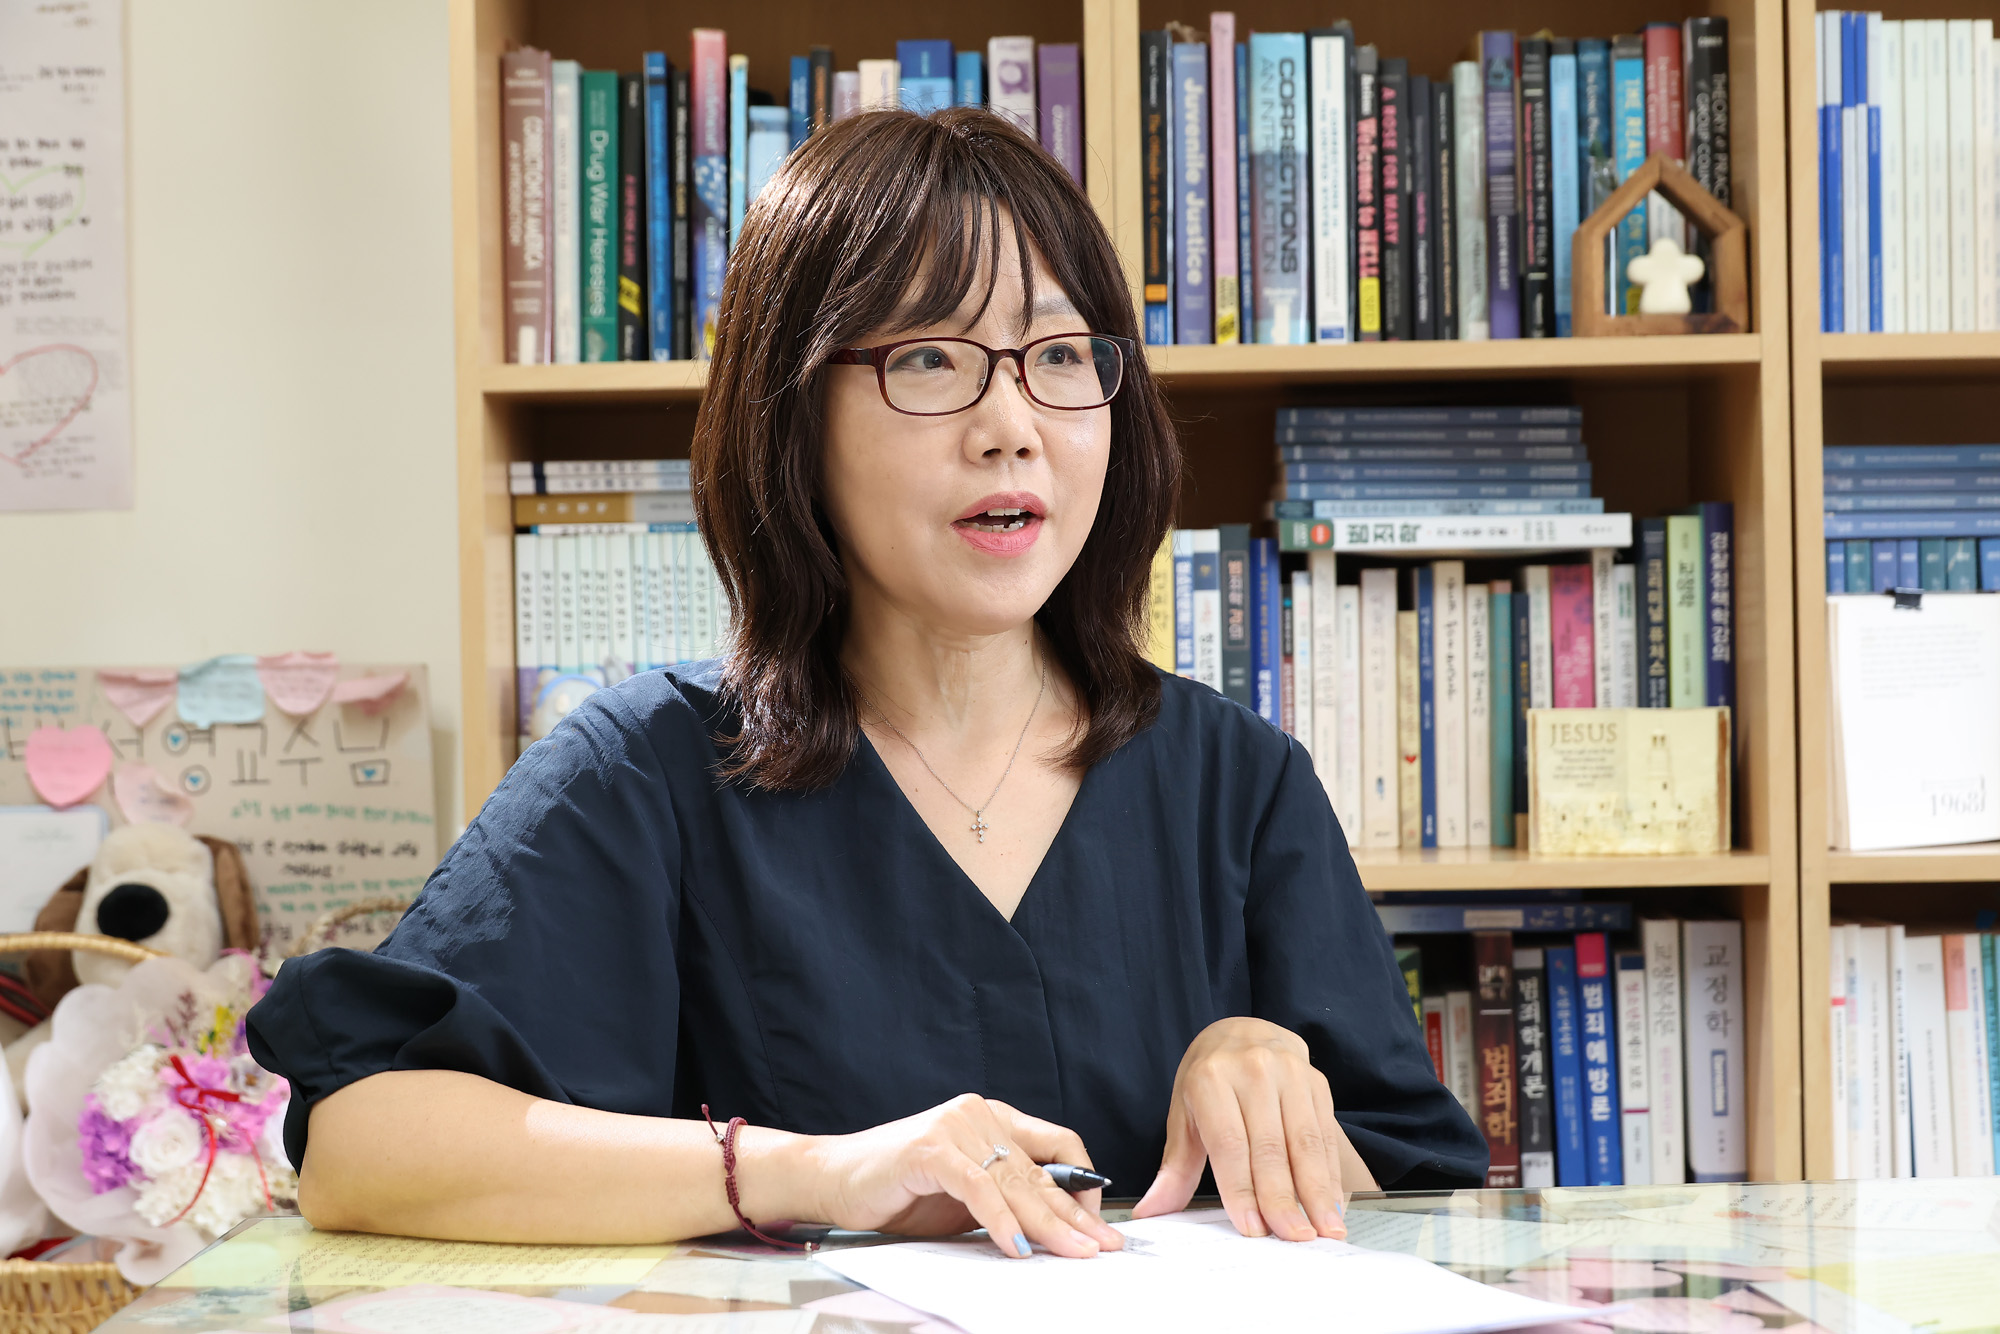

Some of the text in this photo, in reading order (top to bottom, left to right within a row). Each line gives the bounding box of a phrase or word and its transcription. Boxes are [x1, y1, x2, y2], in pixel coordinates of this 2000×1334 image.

[1381, 86, 1397, 101] A
[1382, 104, 1398, 149] ROSE
[1624, 77, 1641, 110] THE
[1696, 92, 1710, 141] GROUP
[1712, 72, 1727, 133] THEORY
[523, 115, 543, 199] CORRECTIONS
[587, 130, 609, 181] Drug
[1260, 57, 1277, 273] AN INTRODUCTION
[1279, 57, 1298, 273] CORRECTIONS
[1330, 107, 1340, 210] CORRECTIONS
[1383, 155, 1398, 189] FOR
[1625, 117, 1642, 159] REAL
[590, 183, 609, 224] War
[1183, 77, 1207, 287] Juvenile Justice
[1357, 117, 1379, 278] Welcome to HELL
[1533, 102, 1547, 266] VOICES FROM THE FIELD
[525, 217, 543, 271] AMERICA
[1384, 194, 1400, 244] MARY
[590, 229, 609, 318] Heresies
[1227, 559, 1244, 606] 범죄학
[1550, 722, 1617, 747] JESUS
[1652, 941, 1676, 1036] 교정복지론
[1702, 944, 1735, 1039] 교정학
[1518, 976, 1547, 1100] 범죄학개론
[1582, 982, 1612, 1122] 범죄예방론
[1482, 1043, 1516, 1145] 범죄학
